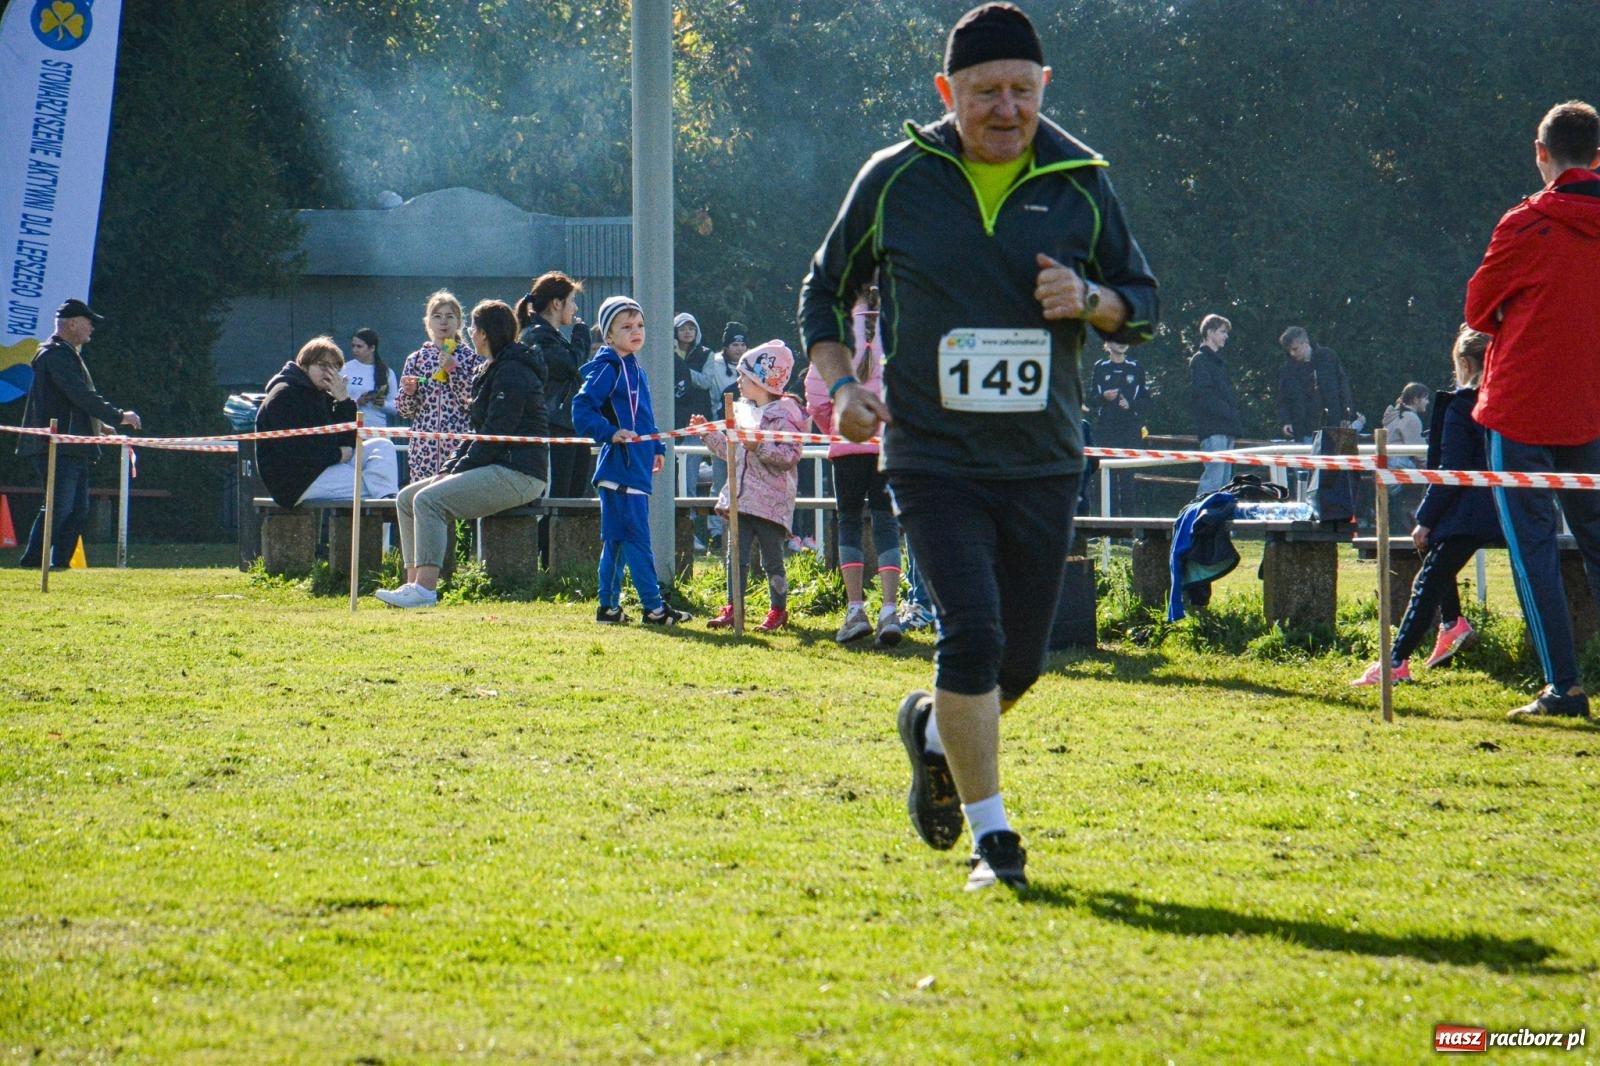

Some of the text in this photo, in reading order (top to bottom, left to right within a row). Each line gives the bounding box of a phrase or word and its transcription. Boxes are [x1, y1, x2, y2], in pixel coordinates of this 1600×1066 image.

[6, 59, 73, 336] STOWARZYSZENIE AKTYWNI DLA LEPSZEGO JUTRA
[352, 376, 363, 386] 22
[949, 358, 1043, 396] 149
